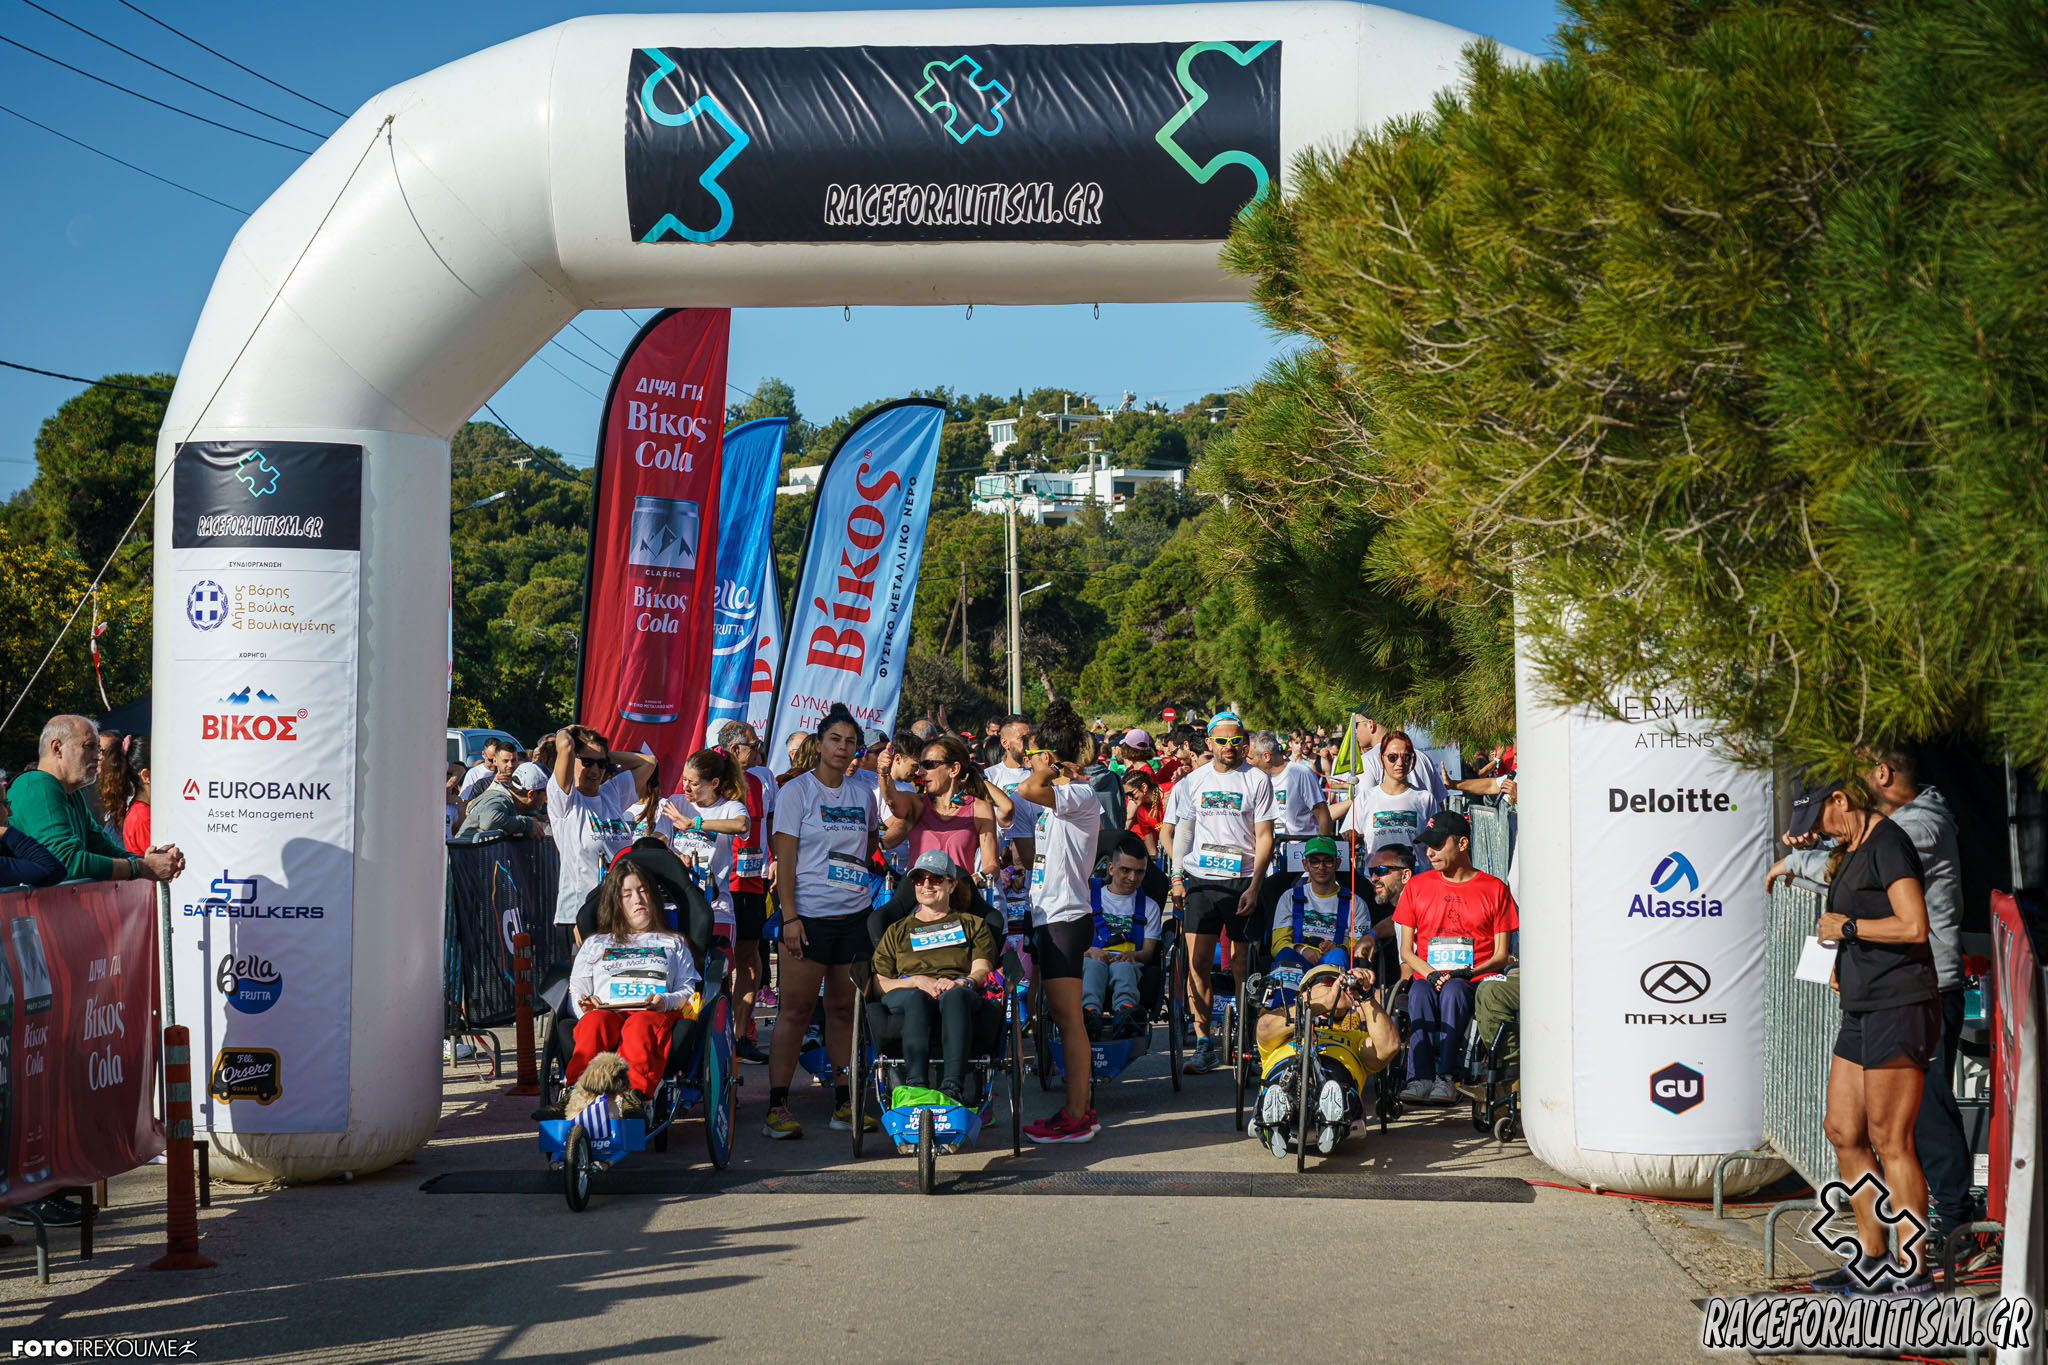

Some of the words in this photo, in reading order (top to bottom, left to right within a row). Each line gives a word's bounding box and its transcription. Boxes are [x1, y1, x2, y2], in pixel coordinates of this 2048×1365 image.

[824, 182, 1104, 226] RACEFORAUTISM.GR
[636, 377, 676, 398] ΔΙΨΑ
[682, 384, 704, 402] ΓΙΑ
[628, 400, 707, 443] Βίκος
[635, 440, 694, 473] Cola
[197, 515, 324, 538] RACEFORAUTISM.GR
[645, 569, 681, 578] CLASSIC
[879, 620, 896, 678] ΦΥΣΙΚΟ
[890, 524, 910, 613] ΜΕΤΑΛΛΙΚΟ
[904, 476, 918, 517] ΝΕΡΟ
[249, 584, 289, 598] Βάρης
[633, 585, 688, 613] Βίκος
[714, 579, 756, 609] ella
[232, 585, 245, 630] Δήμος
[248, 601, 295, 615] Βούλας
[248, 618, 336, 634] Βουλιαγμένης
[636, 612, 679, 633] Cola
[202, 715, 297, 741] ΒΙΚΟΣ
[1635, 732, 1715, 748] ATHENS
[208, 781, 331, 800] EUROBANK
[1609, 788, 1738, 813] Deloitte.
[208, 808, 235, 818] Asset
[238, 809, 314, 821] Management
[207, 824, 238, 833] MFMC
[743, 860, 761, 870] 6345
[1206, 856, 1235, 870] 5542
[835, 867, 864, 883] 5547
[184, 905, 324, 919] SAFEBULKERS
[1628, 894, 1722, 918] Alassia
[920, 932, 957, 945] 5554
[1433, 951, 1466, 962] 5014
[217, 954, 278, 996] Bella
[240, 991, 271, 1000] FRUTTA
[618, 983, 656, 996] 5533
[83, 994, 125, 1040] Βίκος
[1625, 1013, 1727, 1025] MAXUS
[25, 1050, 43, 1077] Cola
[89, 1044, 124, 1090] Cola
[222, 1064, 272, 1083] Orsero
[1655, 1079, 1698, 1098] GU
